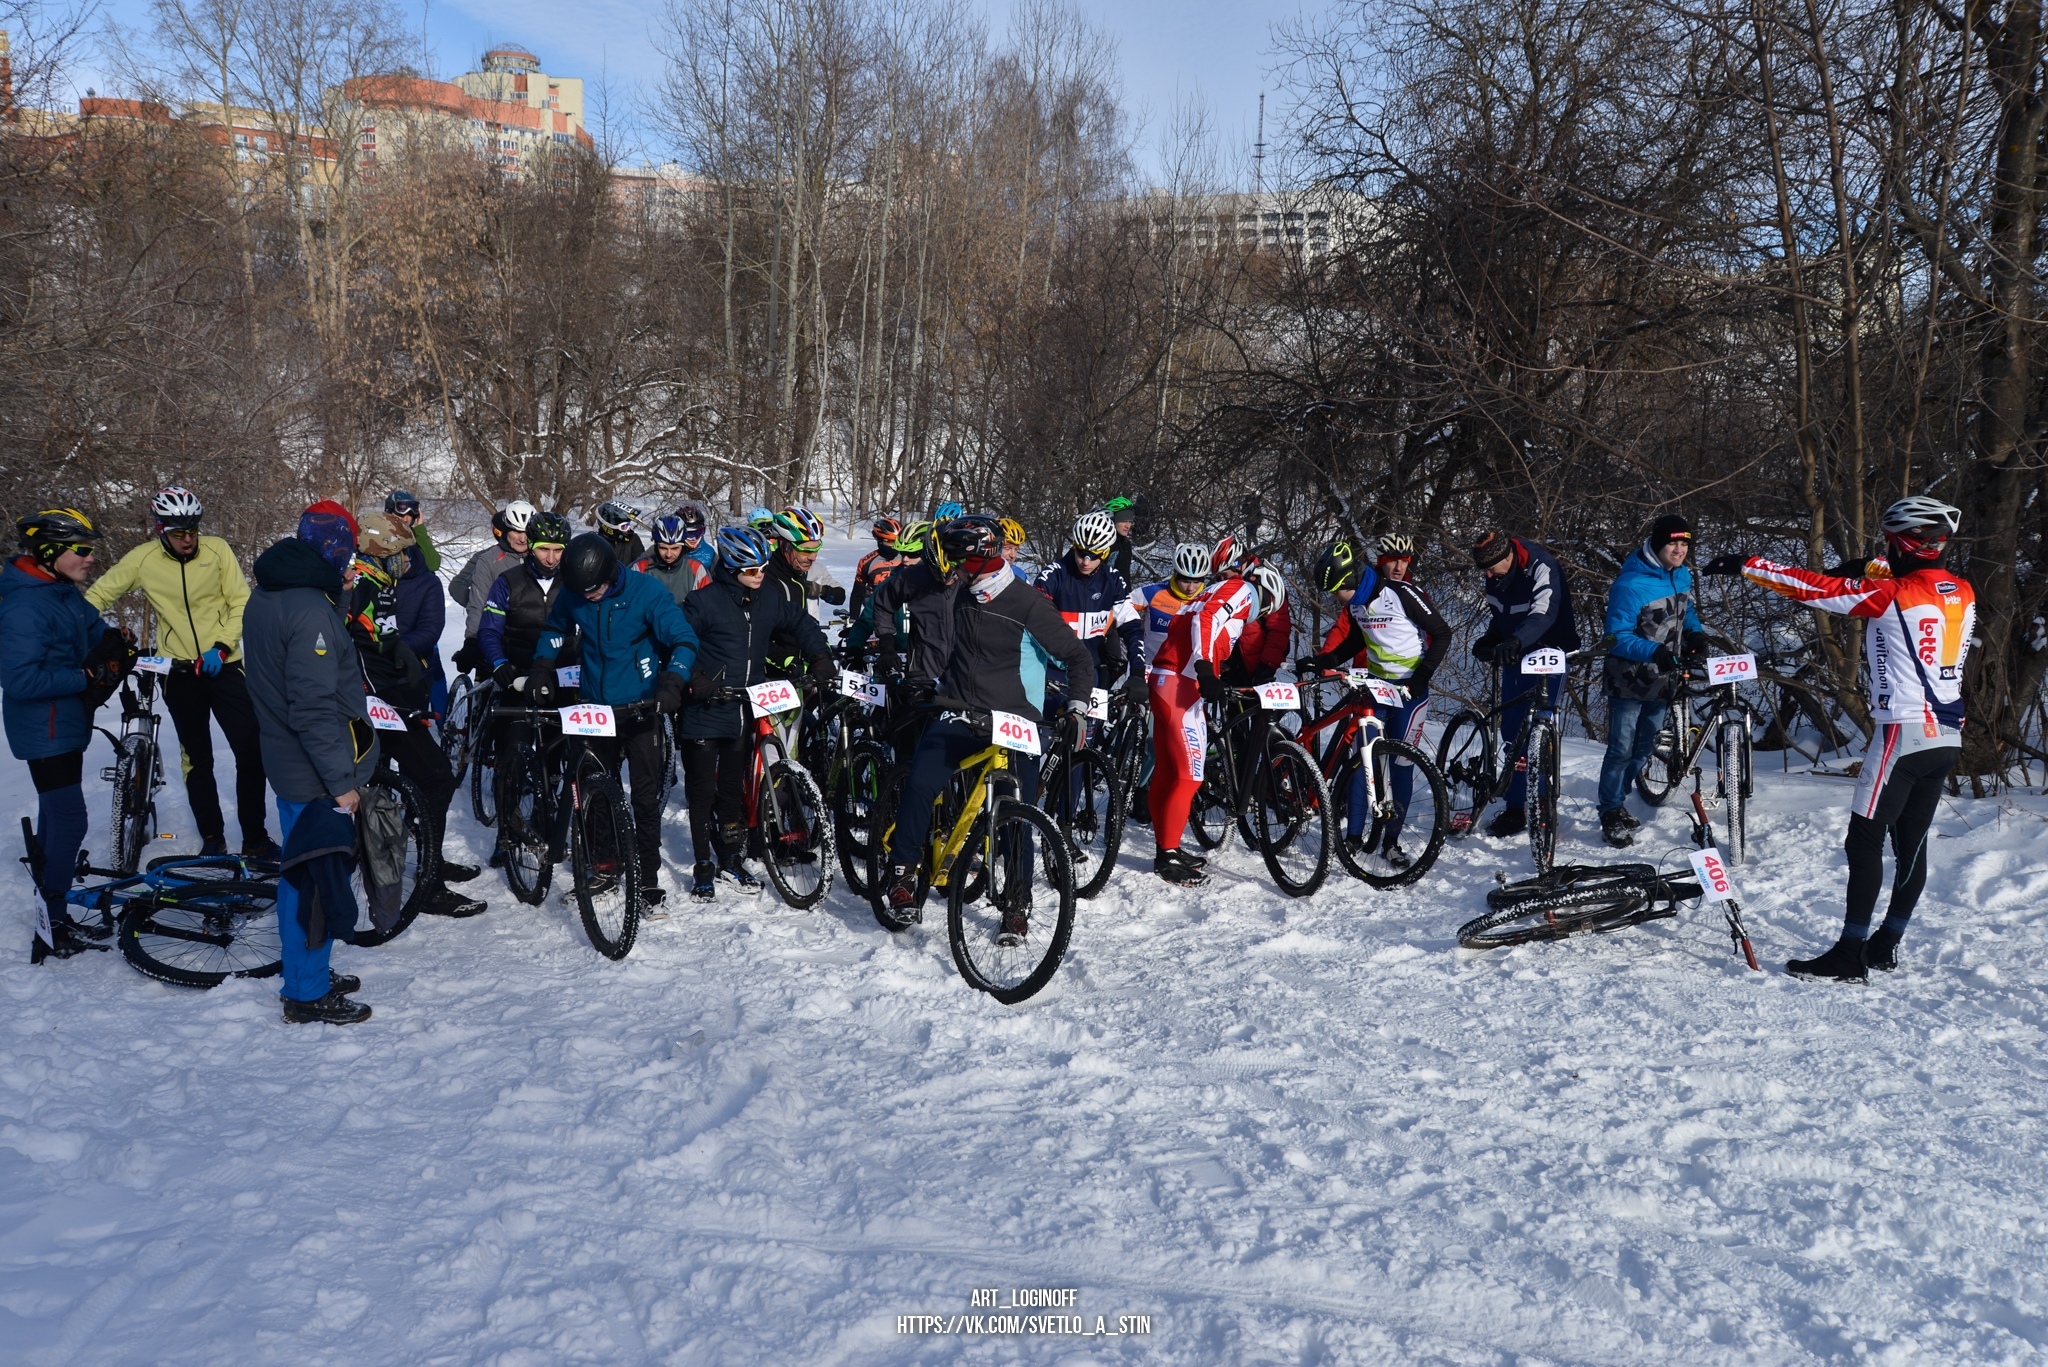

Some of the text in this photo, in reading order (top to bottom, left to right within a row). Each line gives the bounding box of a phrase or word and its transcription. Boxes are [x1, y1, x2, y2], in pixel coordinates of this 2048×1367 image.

[1527, 655, 1559, 666] 515
[1714, 661, 1749, 676] 270
[848, 680, 879, 697] 519
[1265, 688, 1294, 700] 412
[757, 687, 791, 707] 264
[369, 706, 399, 721] 402
[568, 711, 607, 726] 410
[1000, 721, 1032, 743] 401
[1185, 726, 1201, 777] КАТЮША
[1704, 855, 1729, 893] 406
